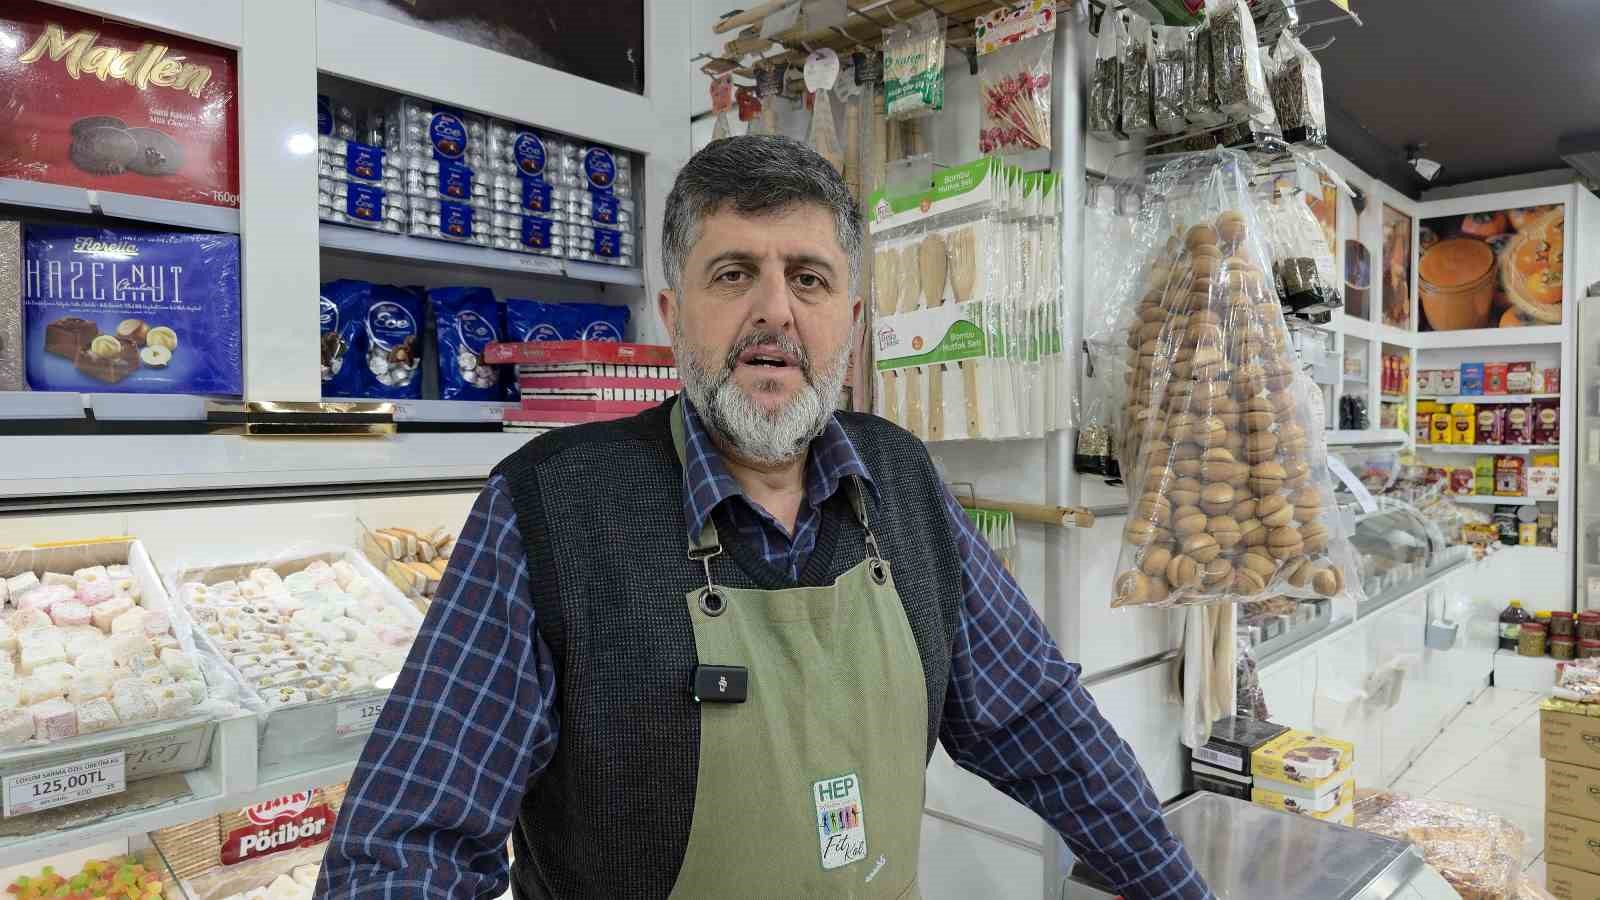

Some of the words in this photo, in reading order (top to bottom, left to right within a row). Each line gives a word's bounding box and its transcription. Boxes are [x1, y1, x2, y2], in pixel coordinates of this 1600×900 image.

[26, 259, 182, 303] HAZELNUT
[32, 771, 106, 797] 125,00TL
[818, 777, 854, 802] HEP
[823, 833, 848, 859] Fit
